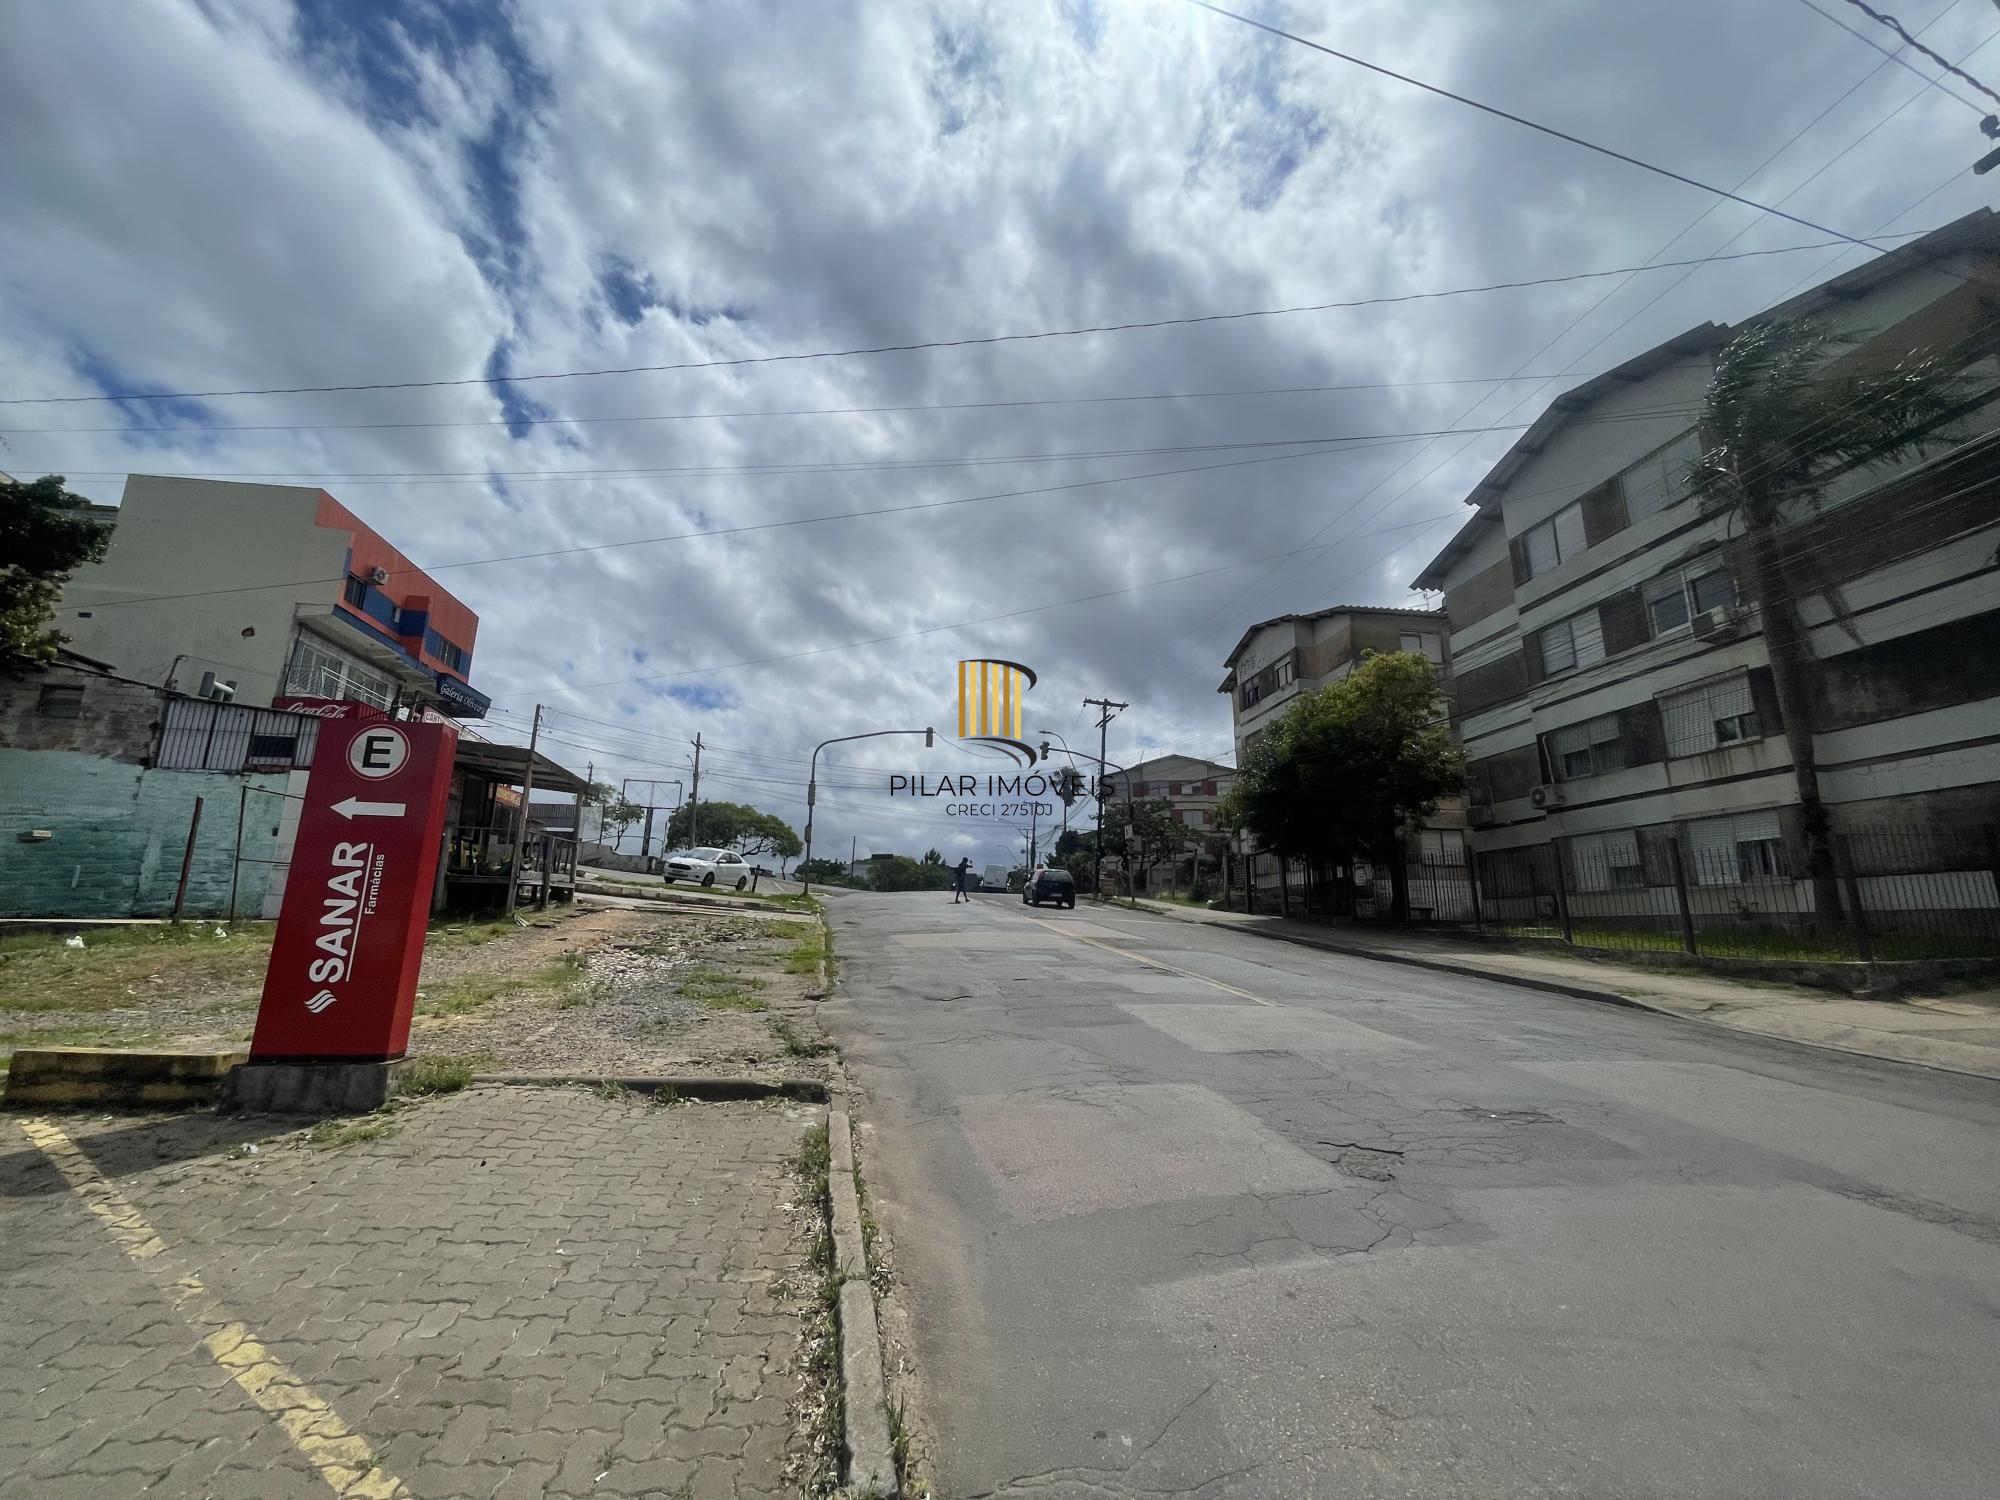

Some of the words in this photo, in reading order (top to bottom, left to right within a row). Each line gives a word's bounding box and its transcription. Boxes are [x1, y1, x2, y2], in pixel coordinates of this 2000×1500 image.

[440, 684, 463, 702] Galeria
[362, 735, 394, 769] E
[364, 853, 385, 915] Farmácias
[308, 841, 368, 984] SANAR
